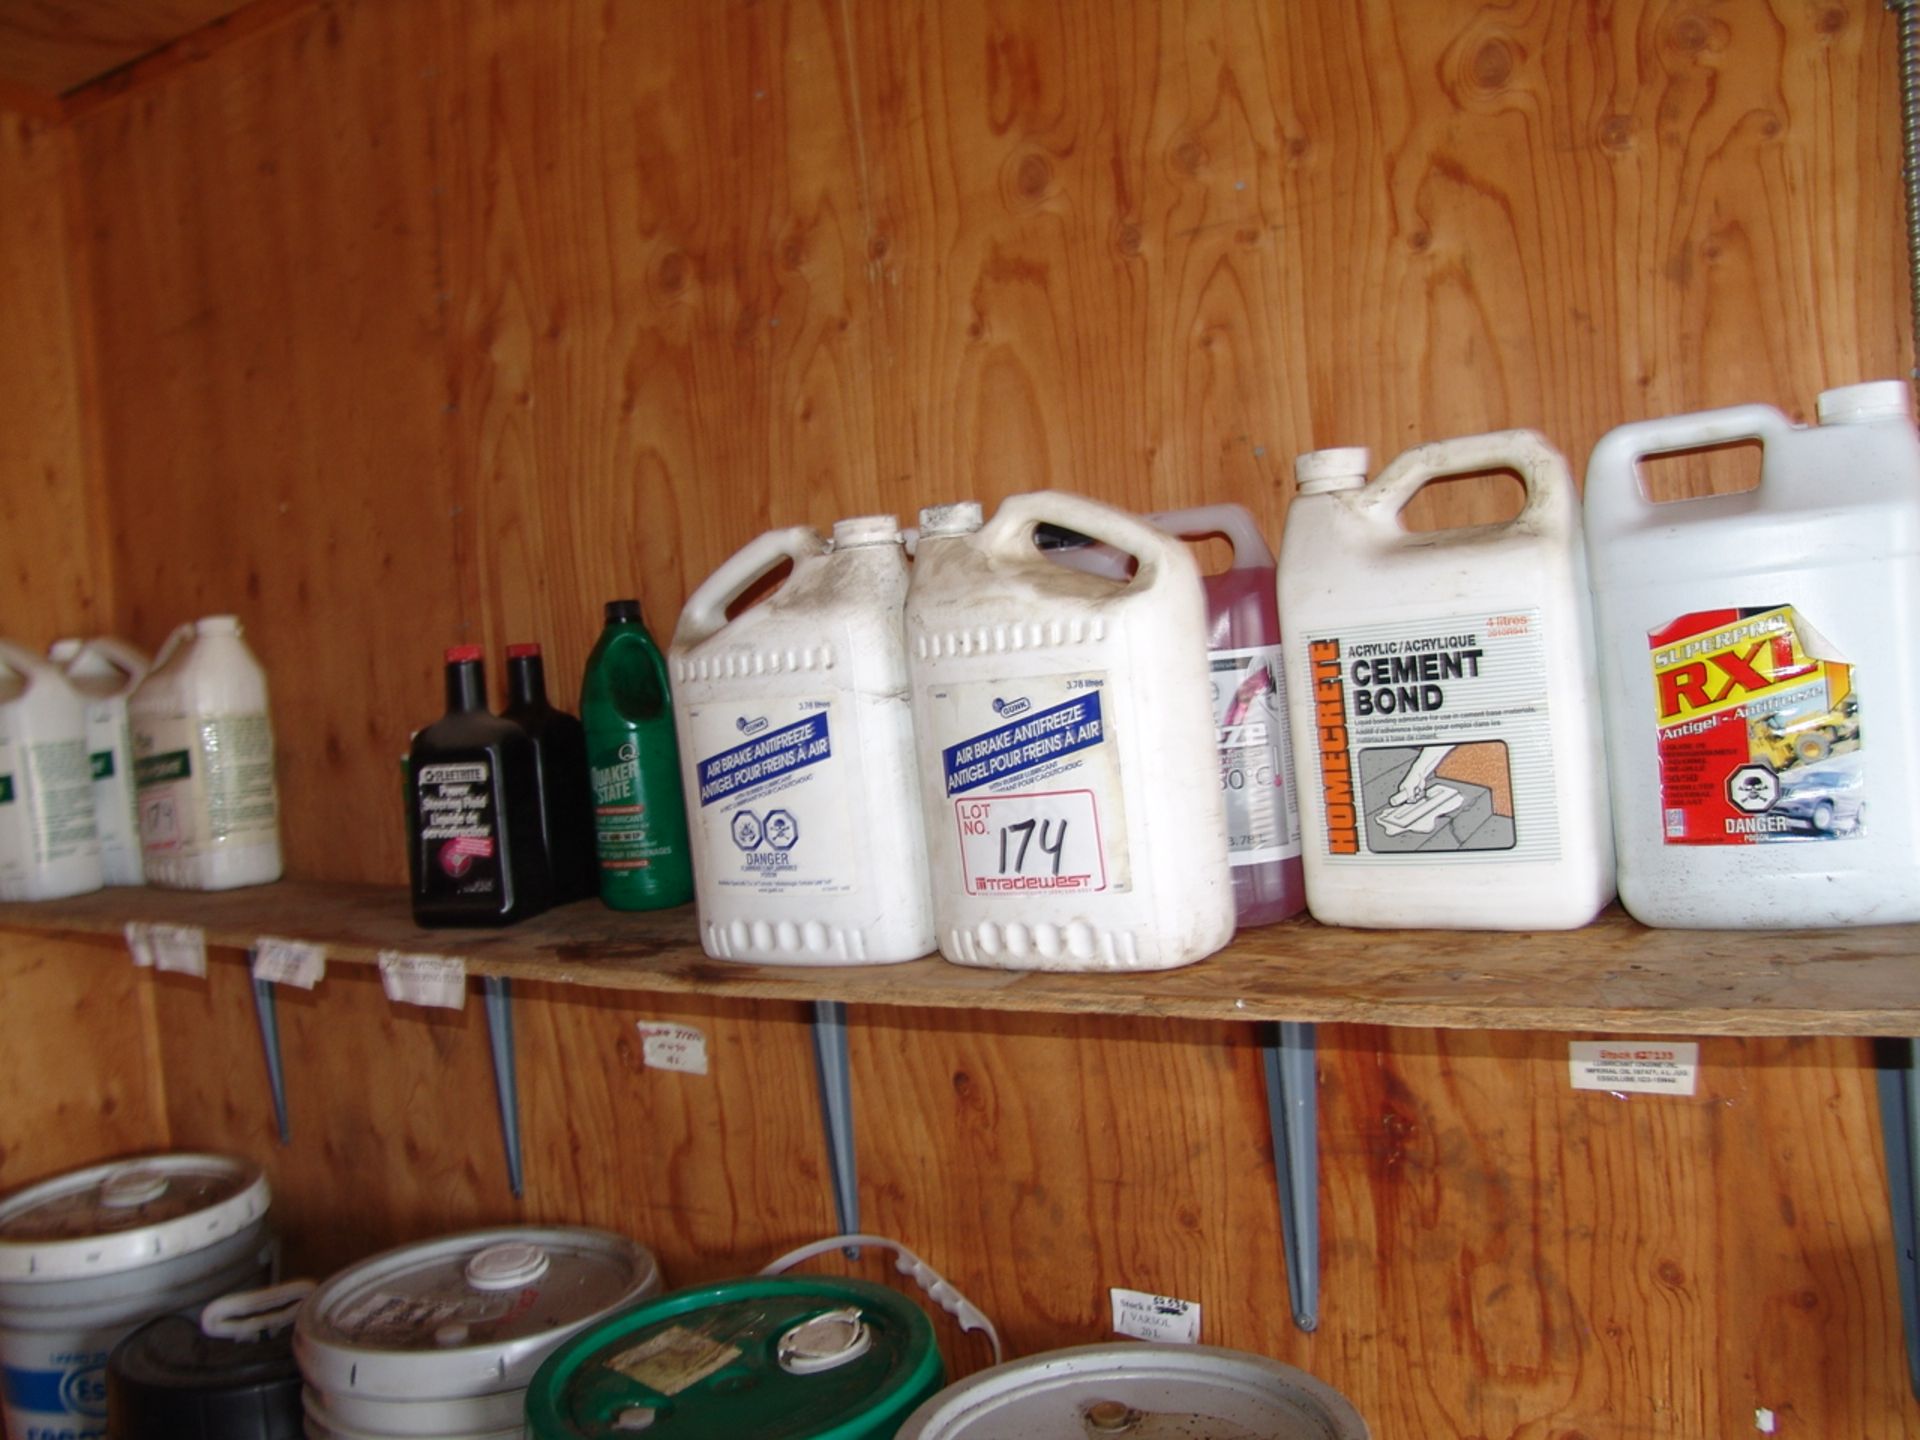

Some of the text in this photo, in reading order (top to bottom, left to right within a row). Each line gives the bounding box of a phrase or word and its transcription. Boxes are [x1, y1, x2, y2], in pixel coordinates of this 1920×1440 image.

[1486, 615, 1529, 627] 4 litres
[1350, 649, 1483, 687] CEMENT
[1656, 636, 1819, 719] RXL
[1002, 701, 1028, 716] GUNK
[1353, 684, 1444, 716] BOND
[1460, 711, 1484, 719] cement
[1662, 716, 1717, 740] Antigel
[955, 703, 1087, 767] AIR BRAKE ANTIFREEZE
[1308, 638, 1360, 855] HOMECRETE
[707, 721, 816, 778] AIR BRAKE ANTIFREEZE
[948, 760, 991, 790] ANTIGEL
[990, 751, 1023, 775] POUR
[1022, 734, 1062, 763] FREINS
[1063, 725, 1075, 746] À
[1077, 722, 1100, 741] AIR
[590, 762, 637, 790] QUAKER
[701, 776, 734, 799] ANTIGEL
[734, 765, 761, 786] POUR
[760, 751, 796, 775] FREINS
[808, 739, 828, 759] AIR
[597, 780, 631, 804] STATE
[961, 803, 991, 820] LOT
[1725, 816, 1787, 834] DANGER
[963, 820, 991, 836] NO.
[746, 852, 790, 866] DANGER
[998, 818, 1068, 876] 174
